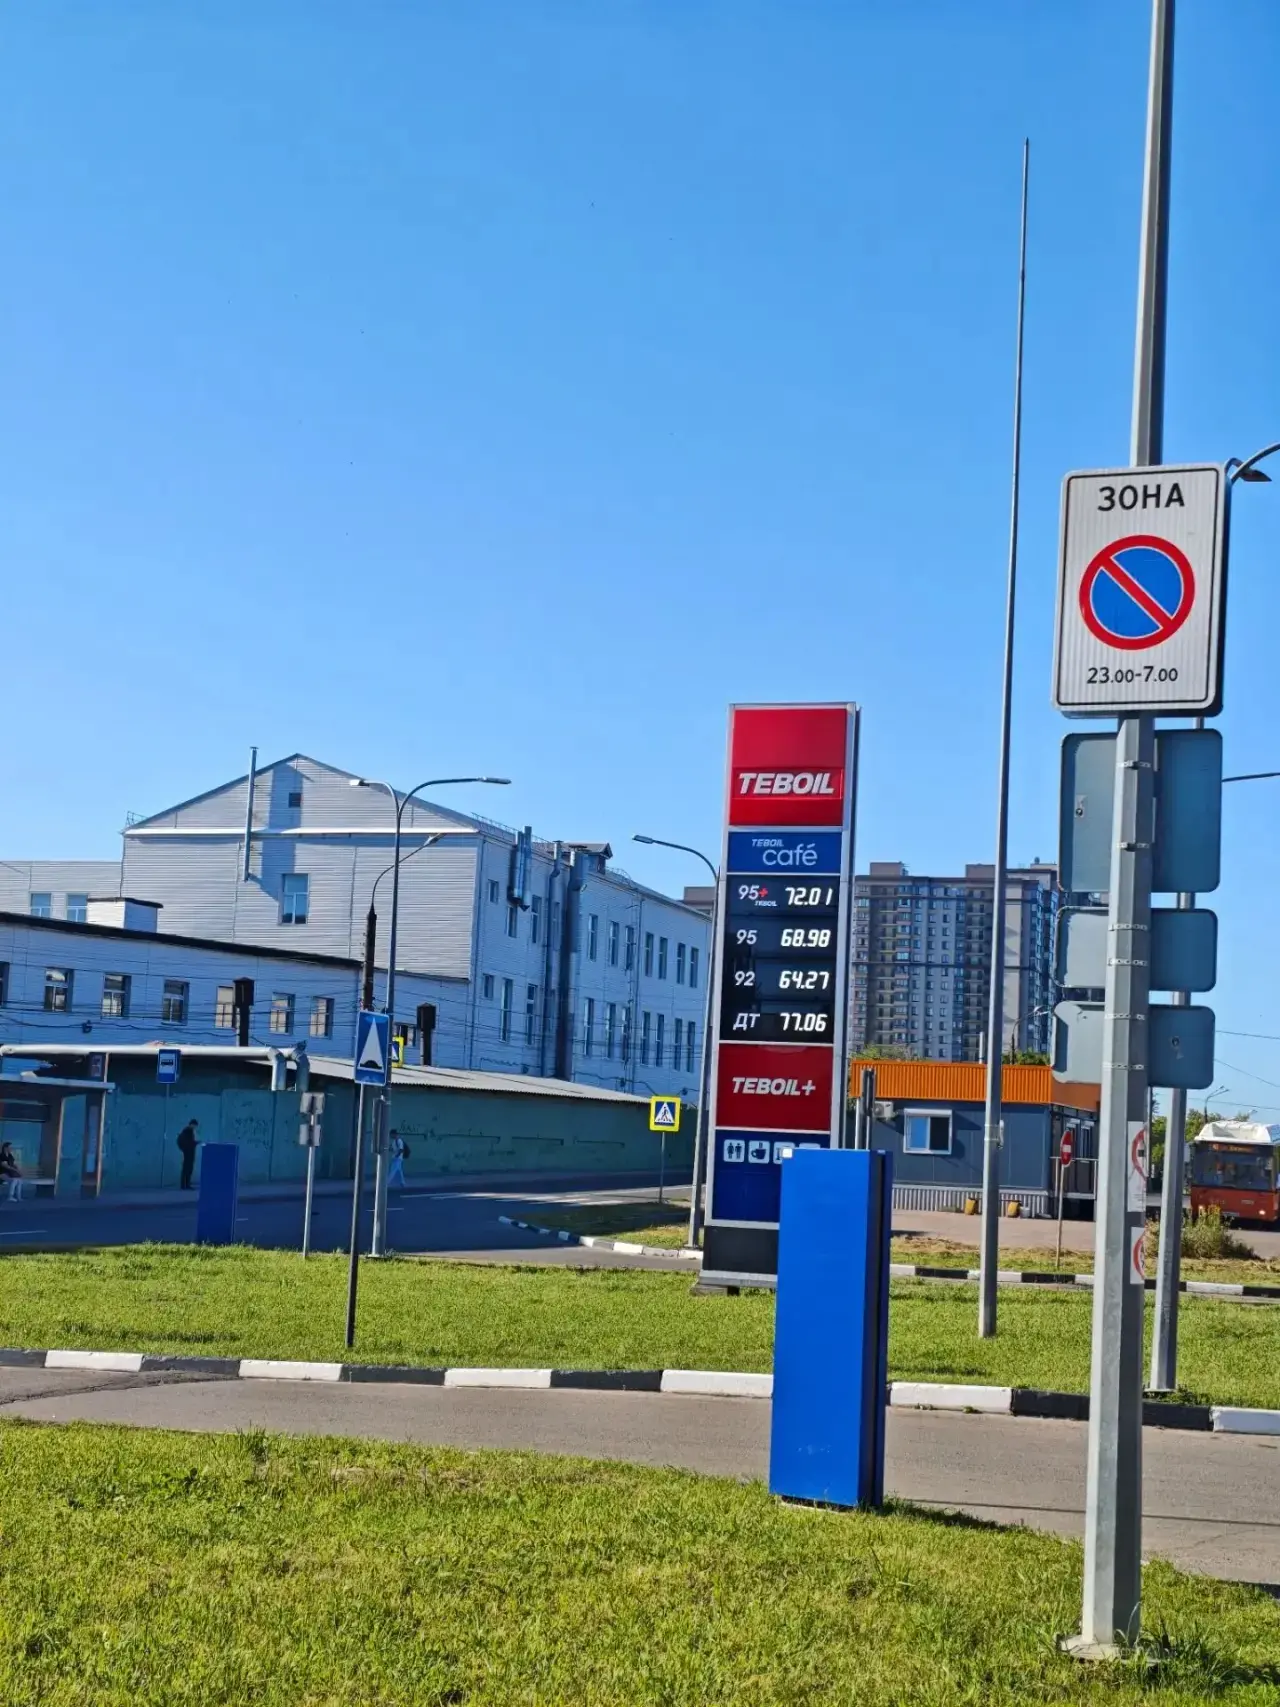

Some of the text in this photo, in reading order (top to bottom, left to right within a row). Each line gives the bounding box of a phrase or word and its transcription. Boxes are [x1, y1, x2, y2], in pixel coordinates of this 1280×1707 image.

[1097, 483, 1185, 512] ЗОНА
[1086, 666, 1178, 684] 23.00-7.00
[739, 772, 835, 795] TEBOIL
[752, 838, 784, 847] TEBOIL
[762, 843, 818, 866] café
[785, 887, 833, 906] 72.01
[736, 929, 831, 948] 95 68.98
[734, 970, 830, 990] 92 64.27
[733, 1012, 828, 1032] ДТ 77.06
[732, 1077, 816, 1096] TEBOIL+
